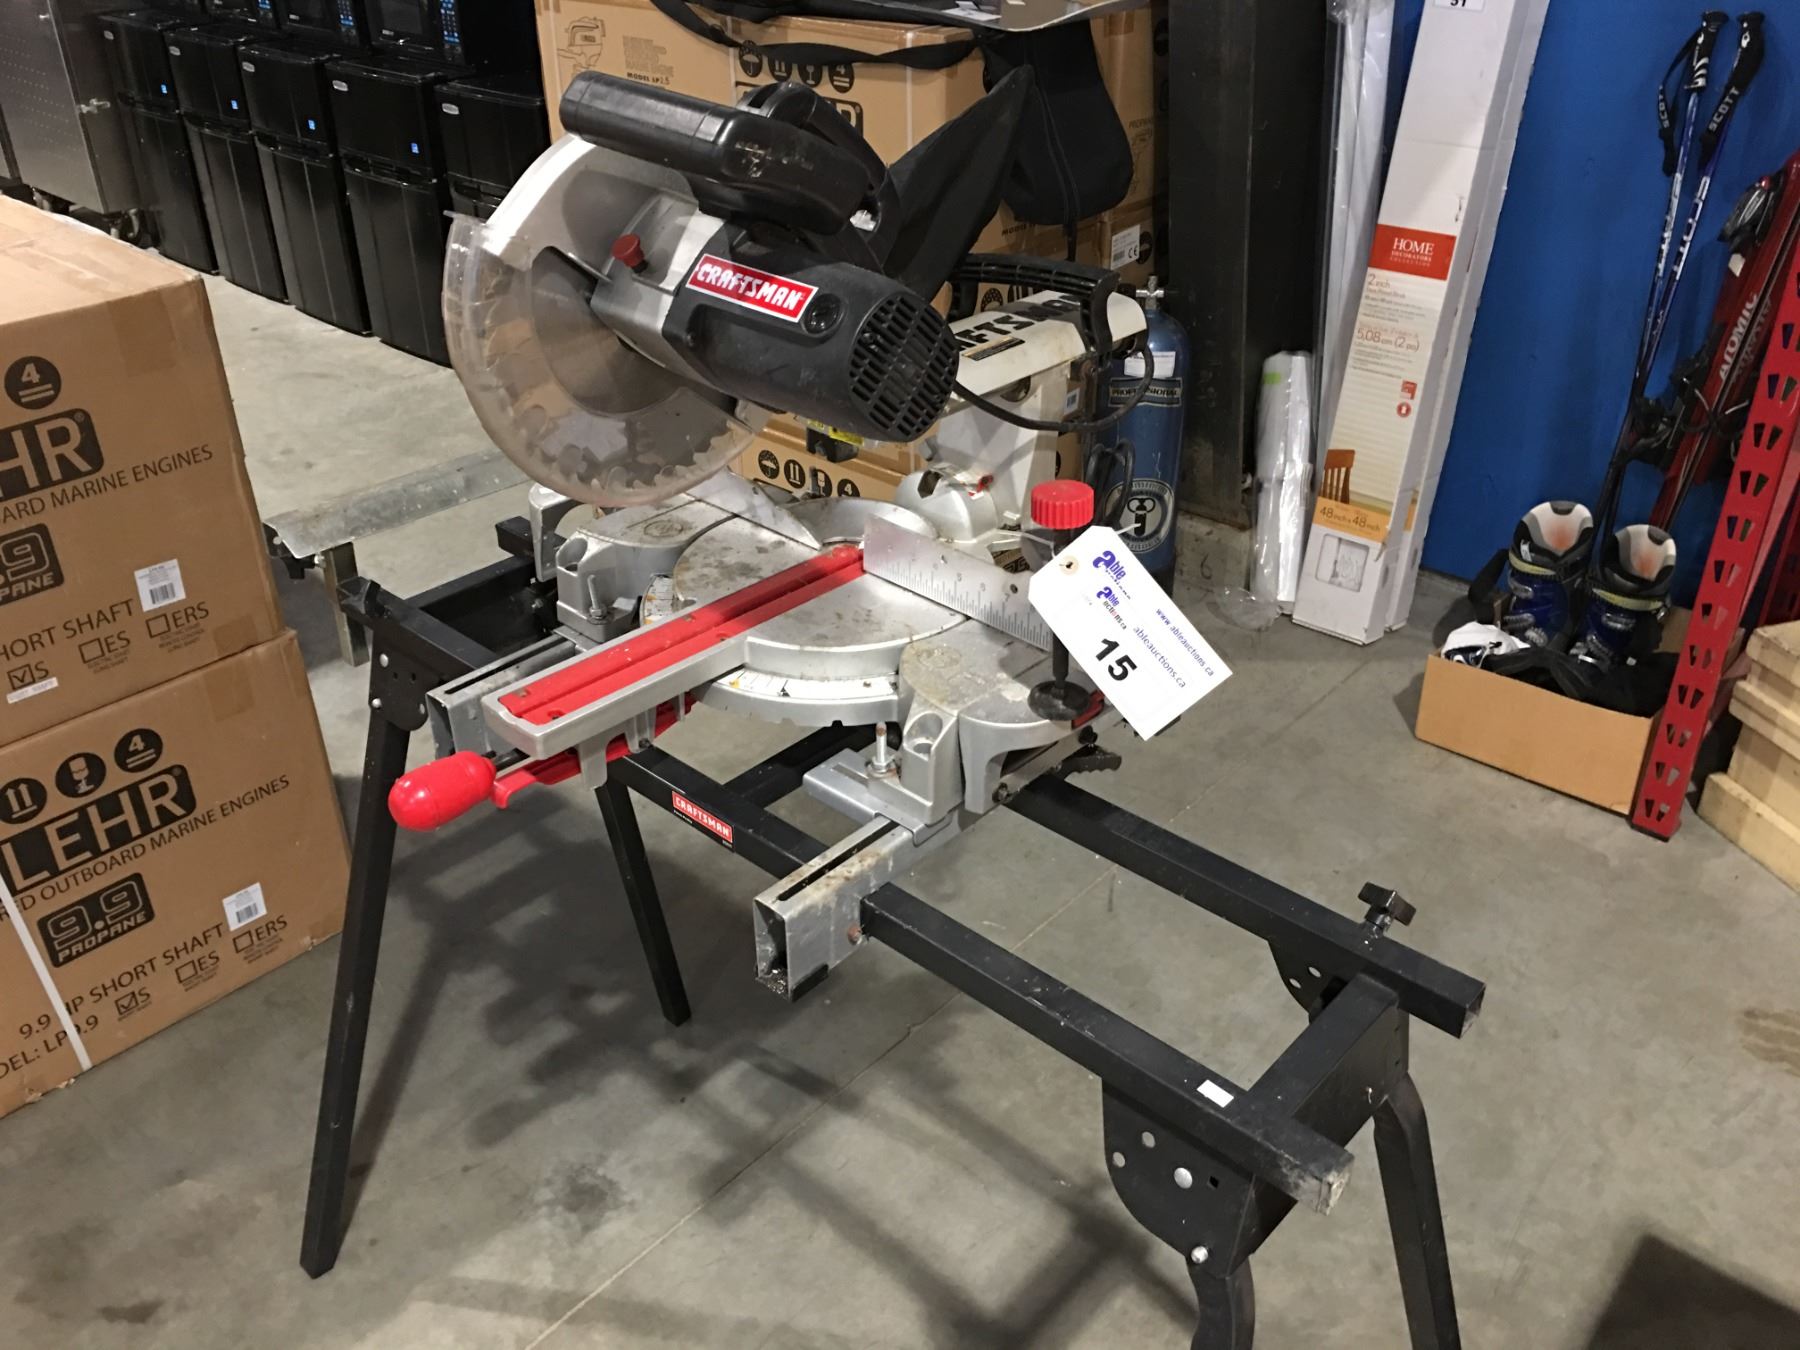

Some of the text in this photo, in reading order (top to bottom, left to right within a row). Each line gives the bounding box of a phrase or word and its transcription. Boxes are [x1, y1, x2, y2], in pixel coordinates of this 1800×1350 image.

[627, 72, 650, 82] MODEL
[1708, 85, 1740, 132] SCOTT
[1393, 237, 1435, 256] HOME
[696, 262, 803, 311] CRAFTSMAN
[1368, 273, 1376, 286] 2
[1719, 293, 1758, 381] ATOMIC
[2, 445, 214, 524] ARD MARINE ENGINES
[1320, 506, 1334, 519] 48
[1352, 515, 1368, 528] 48
[62, 598, 134, 639] SHAFT
[172, 601, 209, 629] ERS
[104, 630, 131, 653] ES
[1095, 638, 1138, 681] 15
[34, 660, 49, 680] S
[1, 772, 188, 891] LEHR
[40, 842, 147, 901] OUTBOARD
[151, 808, 217, 851] MARINE
[220, 773, 290, 819] ENGINES
[675, 796, 729, 837] CRAFTSMAN
[47, 880, 143, 951] 9.9
[256, 914, 288, 940] ERS
[58, 910, 147, 963] PROPANE
[19, 1013, 51, 1040] 9.9
[89, 956, 158, 1004] SHORT
[163, 922, 224, 965] SHAFT
[198, 950, 220, 972] ES
[138, 986, 151, 1004] S
